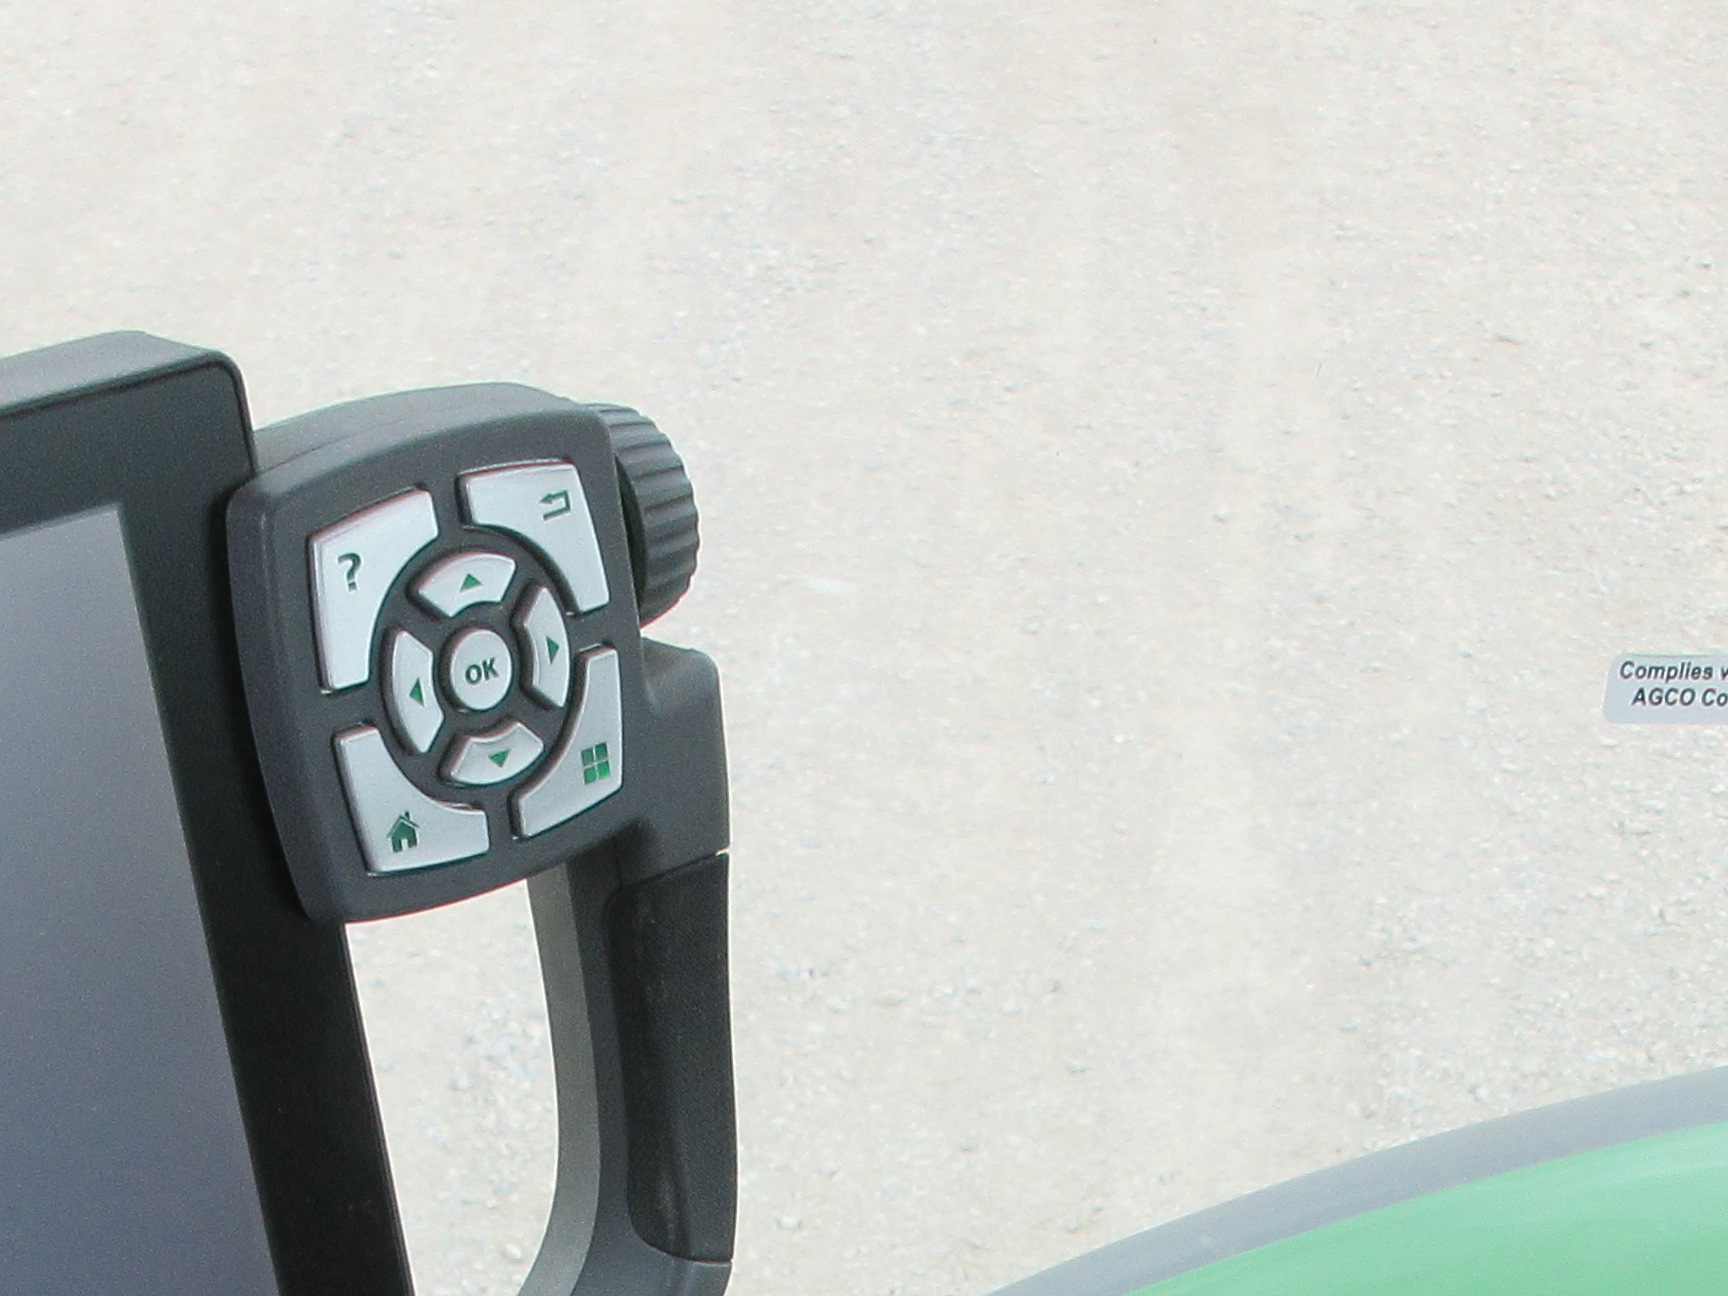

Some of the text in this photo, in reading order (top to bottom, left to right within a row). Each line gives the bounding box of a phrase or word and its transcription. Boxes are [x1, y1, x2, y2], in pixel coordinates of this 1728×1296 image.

[465, 656, 498, 686] OK
[1619, 660, 1714, 683] Complies
[1630, 687, 1696, 706] AGCO
